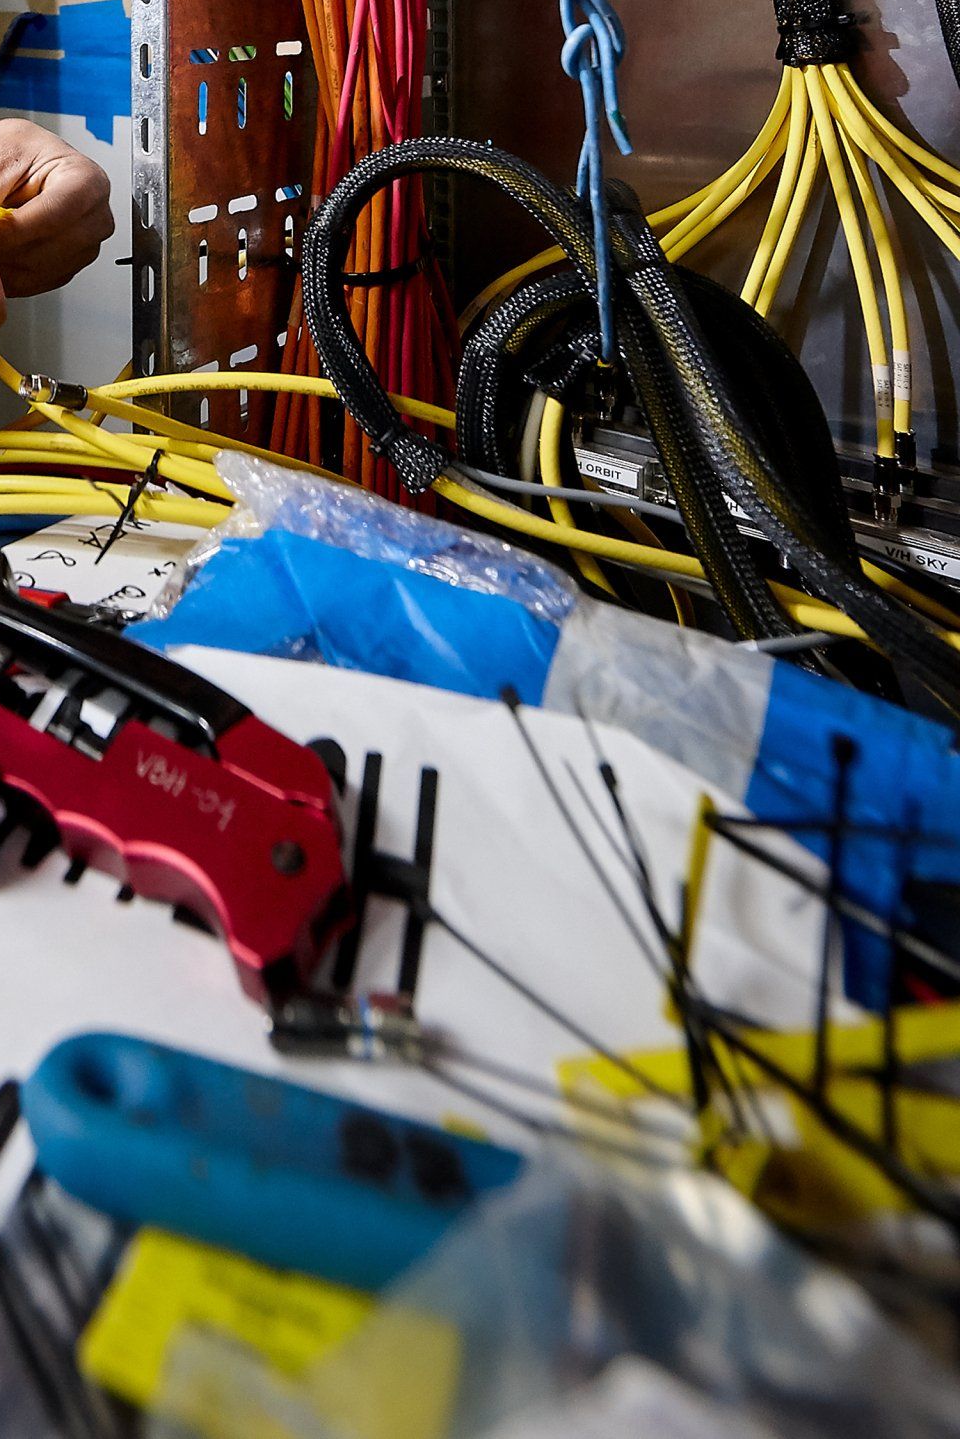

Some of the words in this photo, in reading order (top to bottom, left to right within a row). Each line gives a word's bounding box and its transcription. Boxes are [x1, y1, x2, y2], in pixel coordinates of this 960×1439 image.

[586, 463, 621, 479] ORBIT
[885, 545, 911, 562] V/H
[916, 554, 948, 571] SKY
